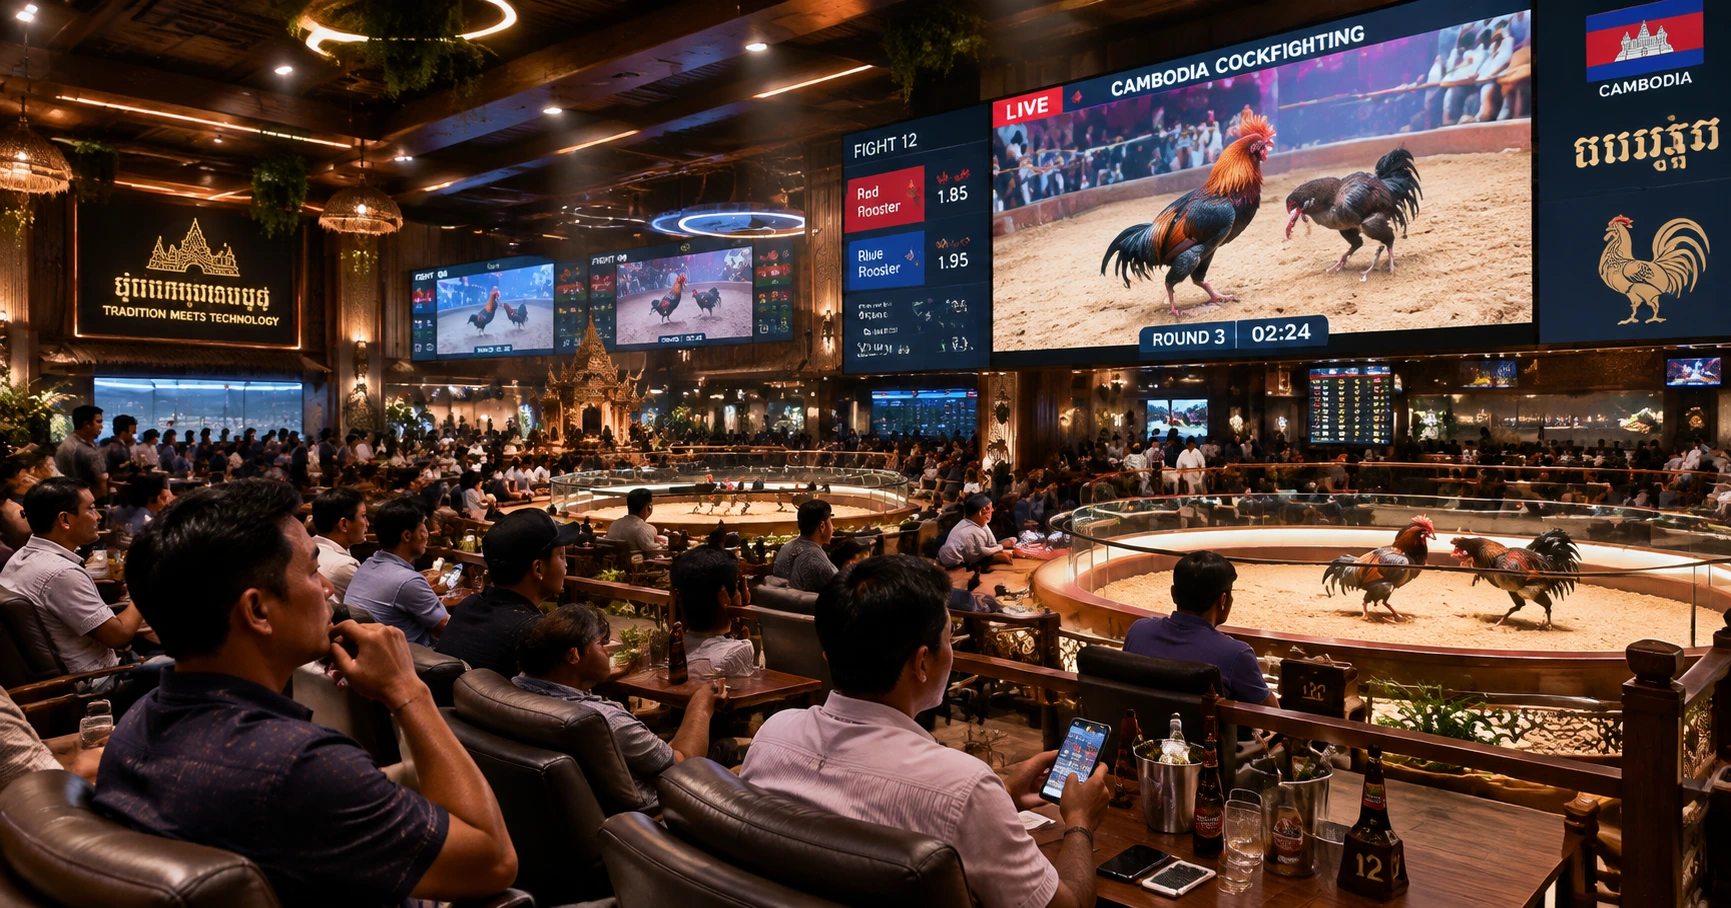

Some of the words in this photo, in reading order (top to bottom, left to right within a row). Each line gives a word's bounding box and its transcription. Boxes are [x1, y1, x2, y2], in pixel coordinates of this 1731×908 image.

[1111, 62, 1209, 97] CAMBODIA
[1215, 25, 1365, 75] COCKFIGHTING
[1599, 71, 1693, 98] CAMBODIA
[1006, 96, 1049, 120] LIVE
[854, 137, 897, 159] FIGHT
[902, 132, 918, 149] 12
[938, 185, 968, 204] 1.85
[938, 252, 969, 270] 1.95
[103, 305, 166, 319] TRADITION
[170, 310, 207, 322] MEETS
[209, 312, 280, 327] TECHNOLOGY
[1153, 330, 1209, 347] ROUND
[1214, 329, 1225, 344] 3
[1251, 323, 1311, 343] 02:24
[1356, 852, 1384, 883] 12
